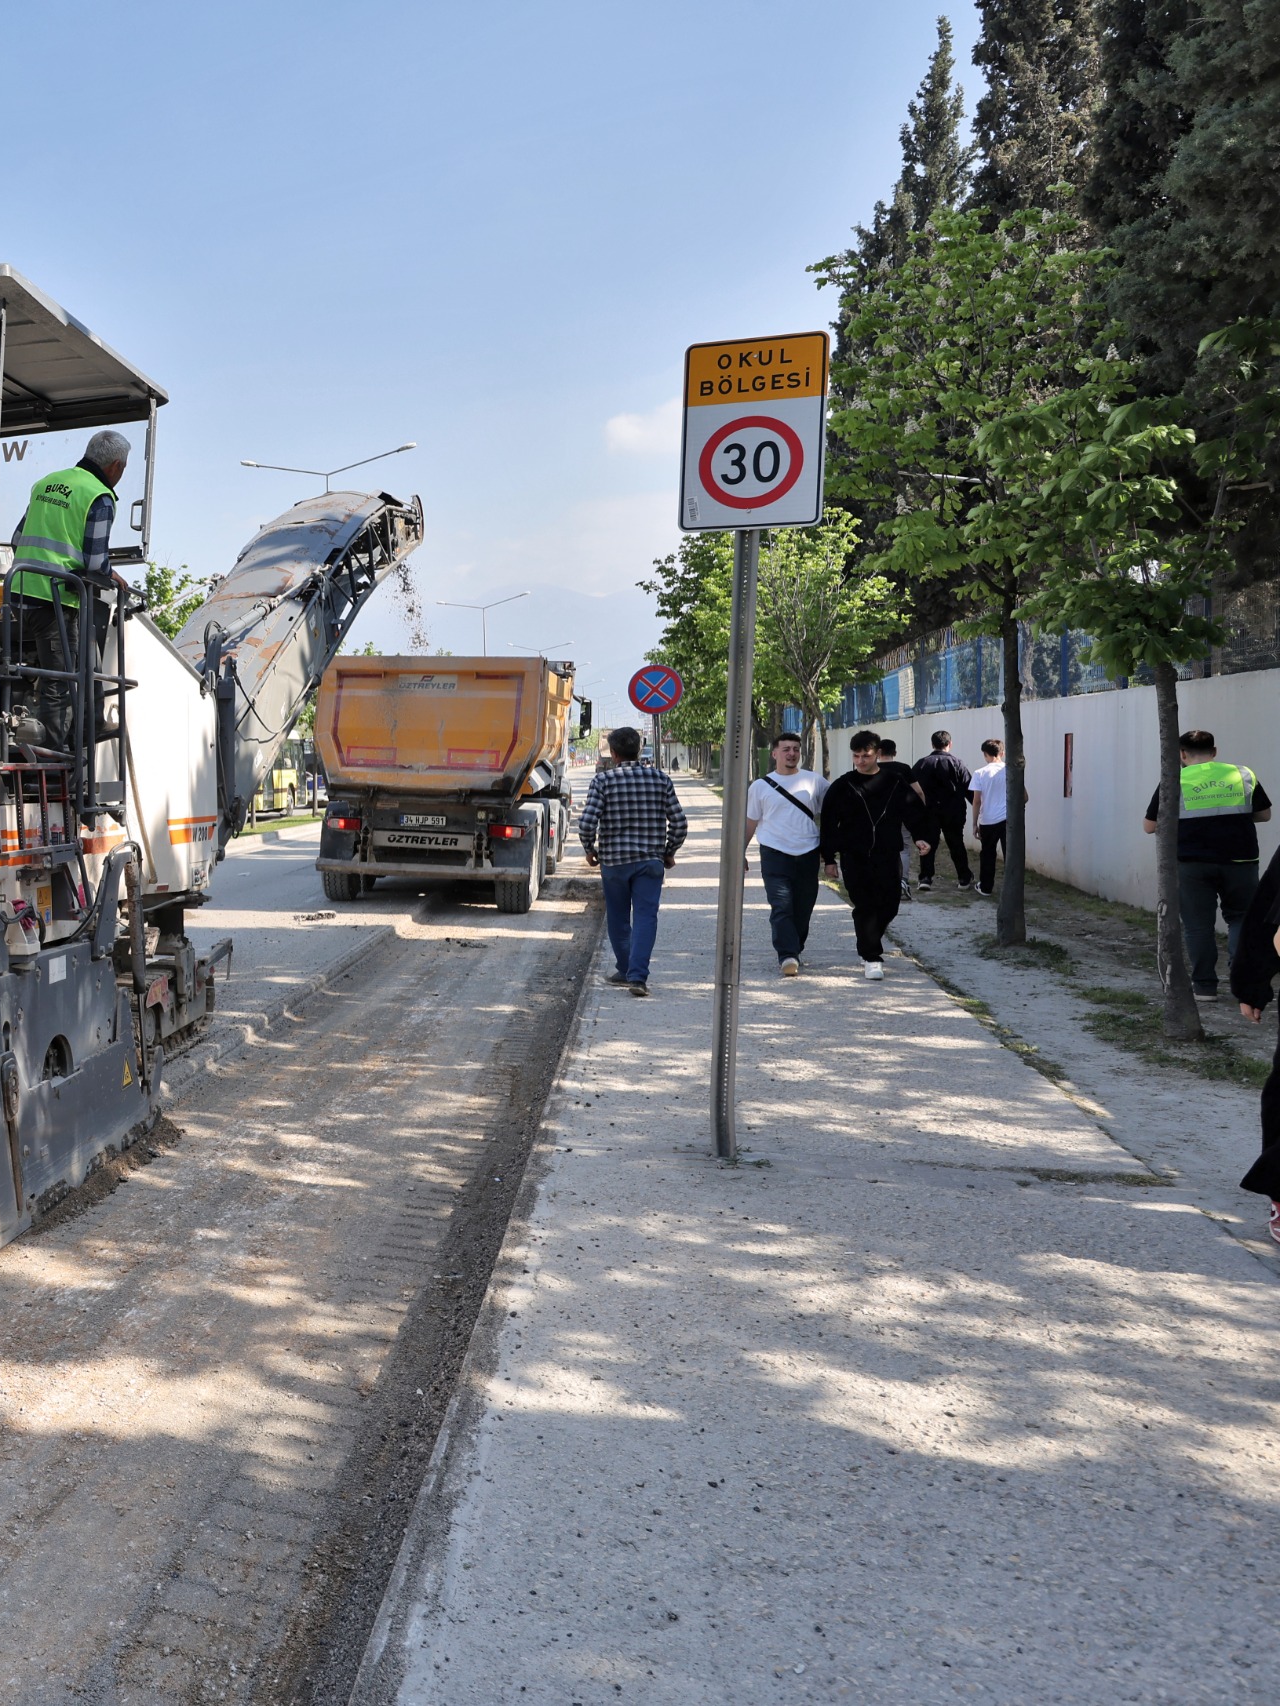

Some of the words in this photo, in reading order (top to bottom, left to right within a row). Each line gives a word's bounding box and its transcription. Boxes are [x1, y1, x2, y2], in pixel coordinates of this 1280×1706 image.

[717, 348, 792, 370] OKUL
[699, 367, 810, 397] BÖLGESİ
[720, 440, 781, 486] 30
[45, 484, 72, 499] BURSA
[1192, 780, 1234, 794] BURSA
[404, 816, 413, 824] 34
[431, 817, 444, 825] 591
